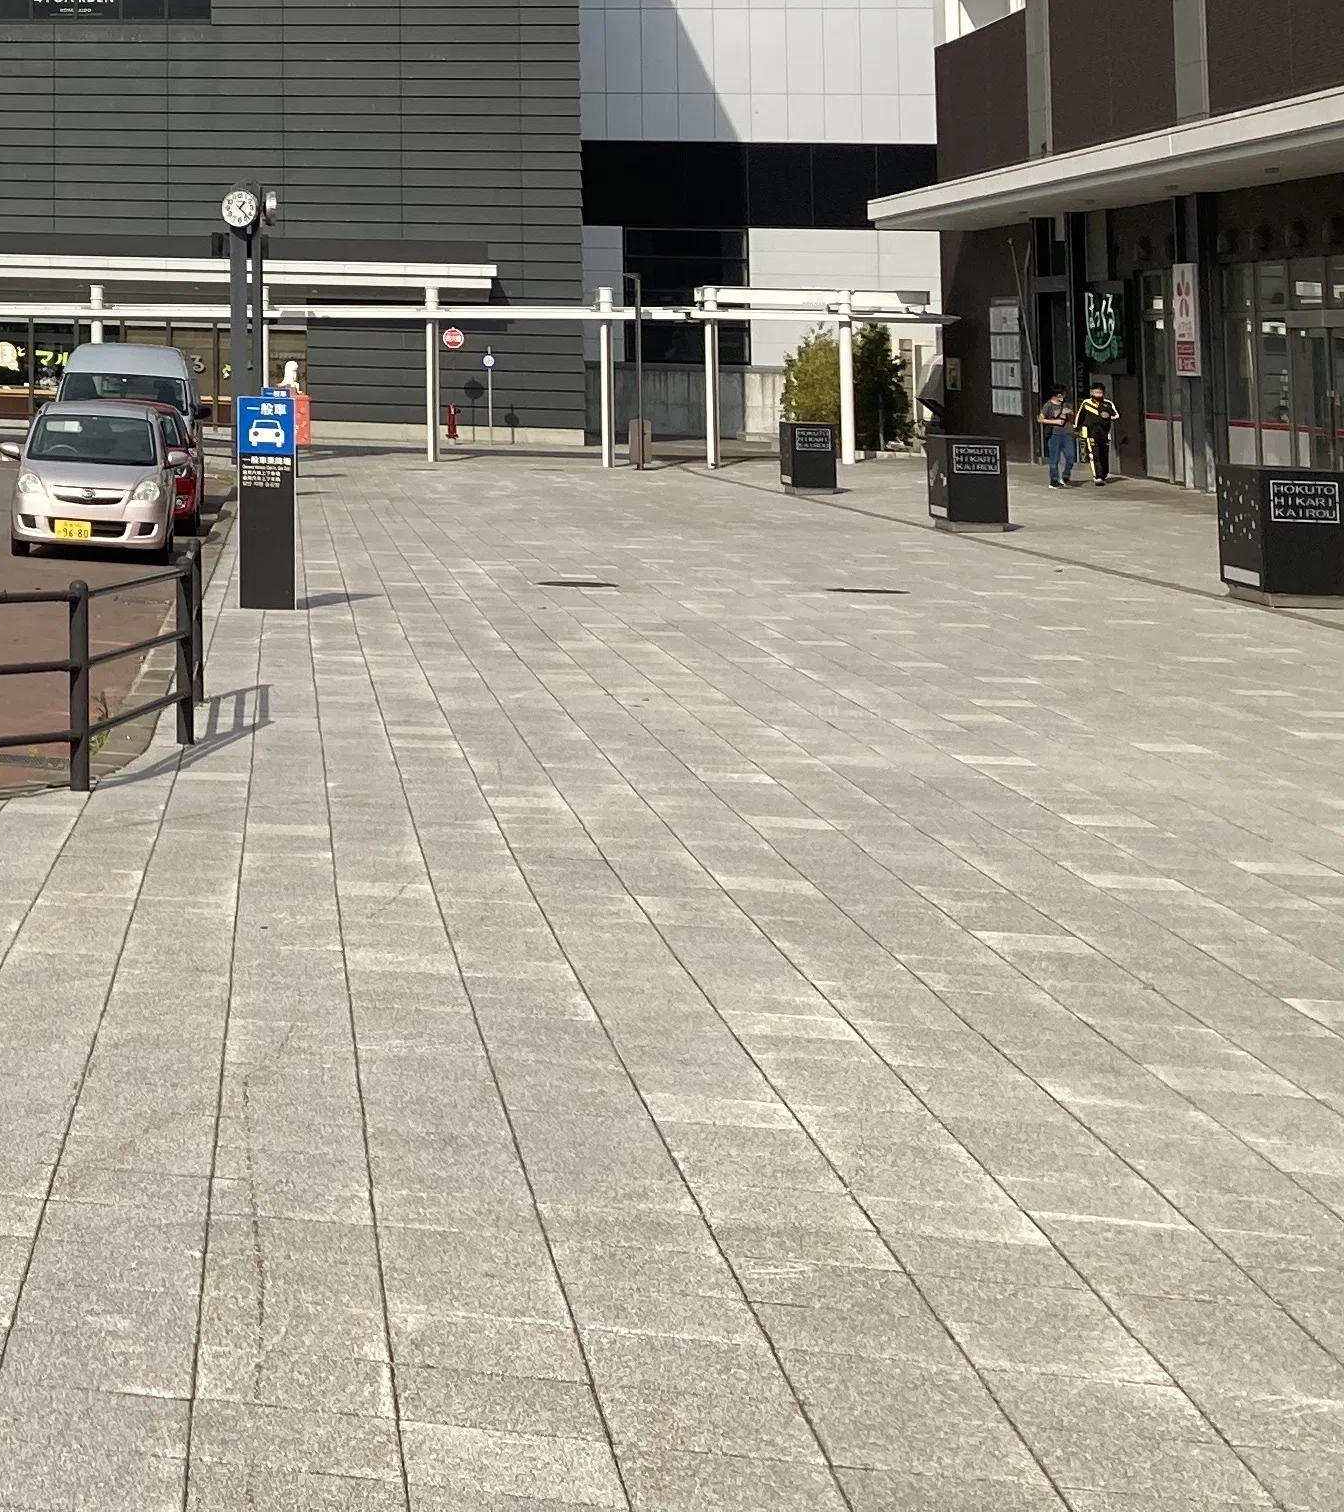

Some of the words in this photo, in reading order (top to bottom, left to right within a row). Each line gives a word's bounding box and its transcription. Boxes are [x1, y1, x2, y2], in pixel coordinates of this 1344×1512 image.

[246, 402, 288, 417] 一般車
[1273, 484, 1336, 495] HOKUTO
[1274, 496, 1333, 507] HIKARI
[1275, 508, 1336, 519] KAIROU
